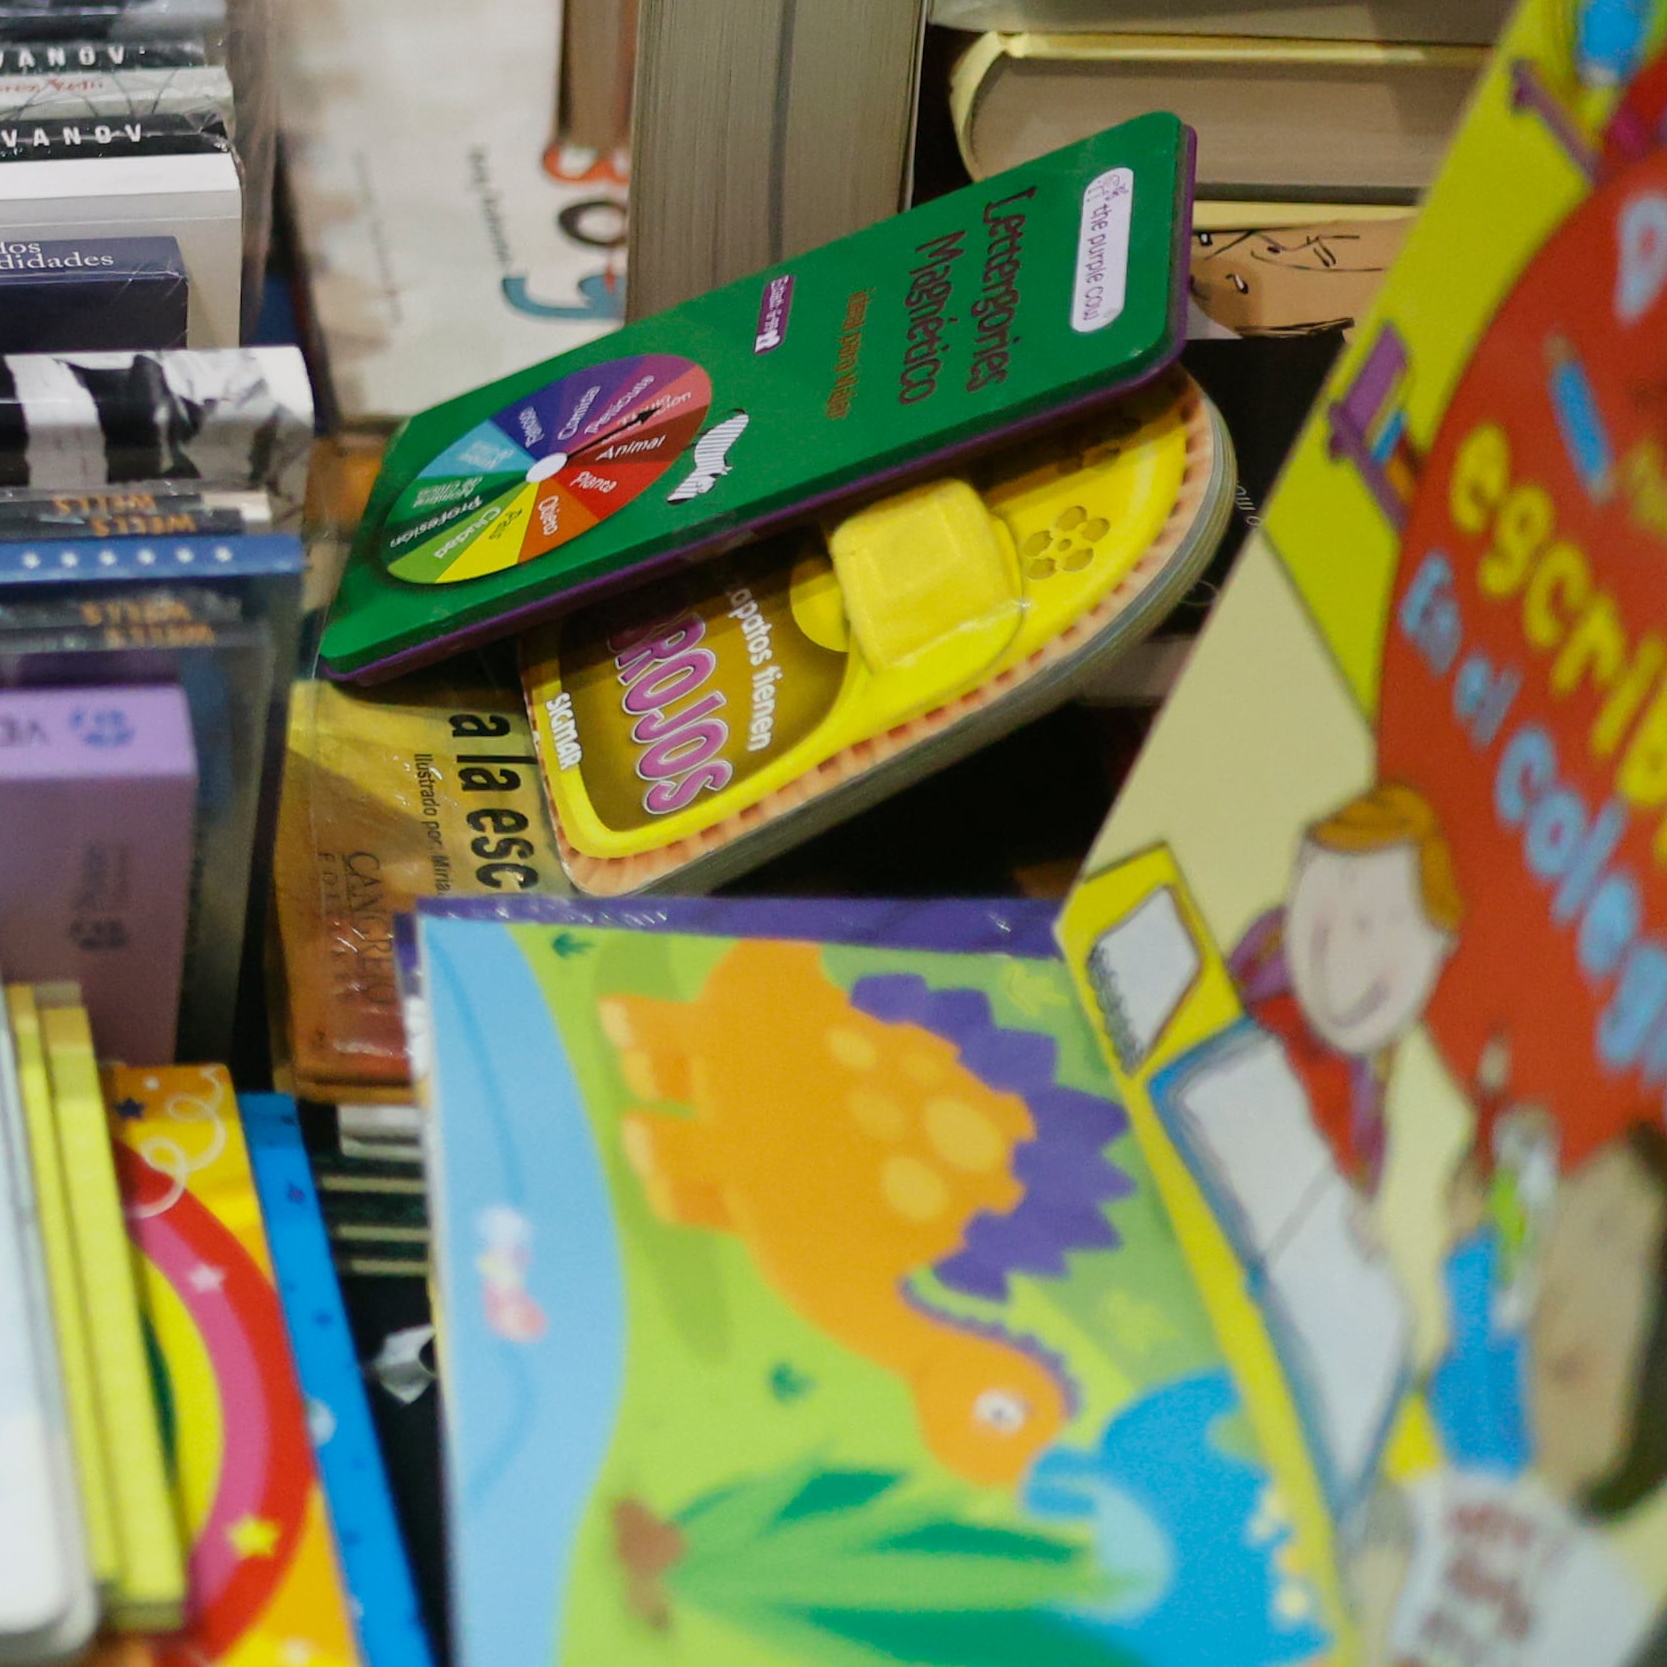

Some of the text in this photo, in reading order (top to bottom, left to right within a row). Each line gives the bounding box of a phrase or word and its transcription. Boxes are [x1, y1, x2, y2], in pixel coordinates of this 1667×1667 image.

[966, 185, 1040, 393] Lettergories
[1083, 203, 1115, 322] the purple cow
[898, 229, 968, 407] Magnético
[569, 470, 619, 495] Planta
[594, 435, 667, 462] Animal
[53, 494, 157, 516] WELLS
[90, 512, 199, 537] WELLS
[607, 612, 734, 816] ROJOS
[726, 586, 788, 752] apatos tienen
[545, 691, 583, 771] SIGMAR
[413, 752, 438, 819] Ilustrado
[447, 714, 541, 892] a la esc
